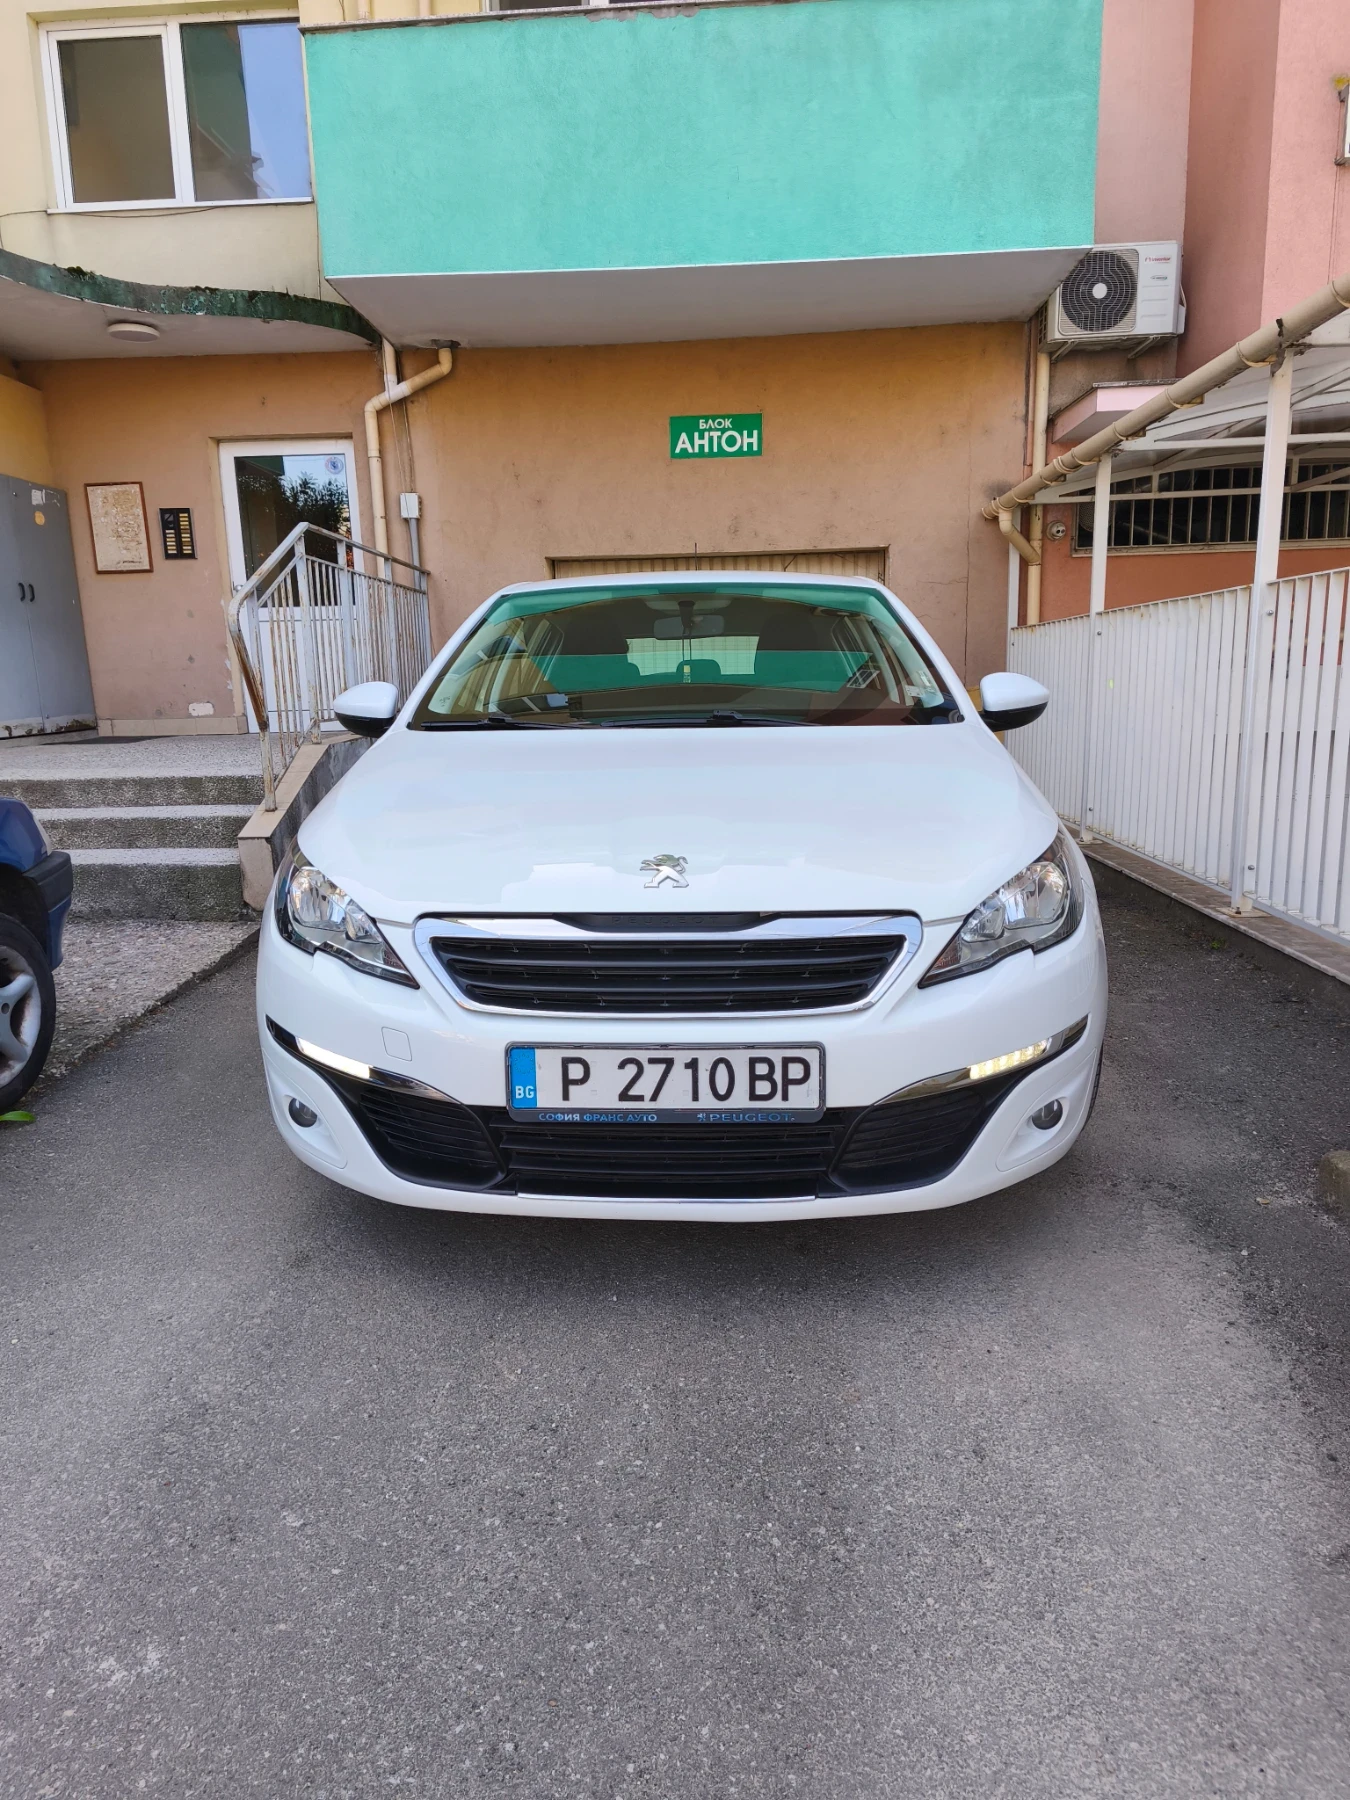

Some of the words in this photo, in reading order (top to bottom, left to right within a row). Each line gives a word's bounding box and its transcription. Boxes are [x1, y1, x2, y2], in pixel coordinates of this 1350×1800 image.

[699, 418, 733, 429] БЛОК
[675, 430, 758, 453] АНТОН
[611, 916, 719, 924] PEUGEOT
[561, 1056, 591, 1102] P
[617, 1056, 736, 1102] 2710
[515, 1085, 535, 1099] BG
[538, 1113, 580, 1121] СОФИЯ
[583, 1113, 623, 1122] ФРАНС
[626, 1113, 658, 1122] АУТО
[709, 1113, 792, 1122] PEUGEOT
